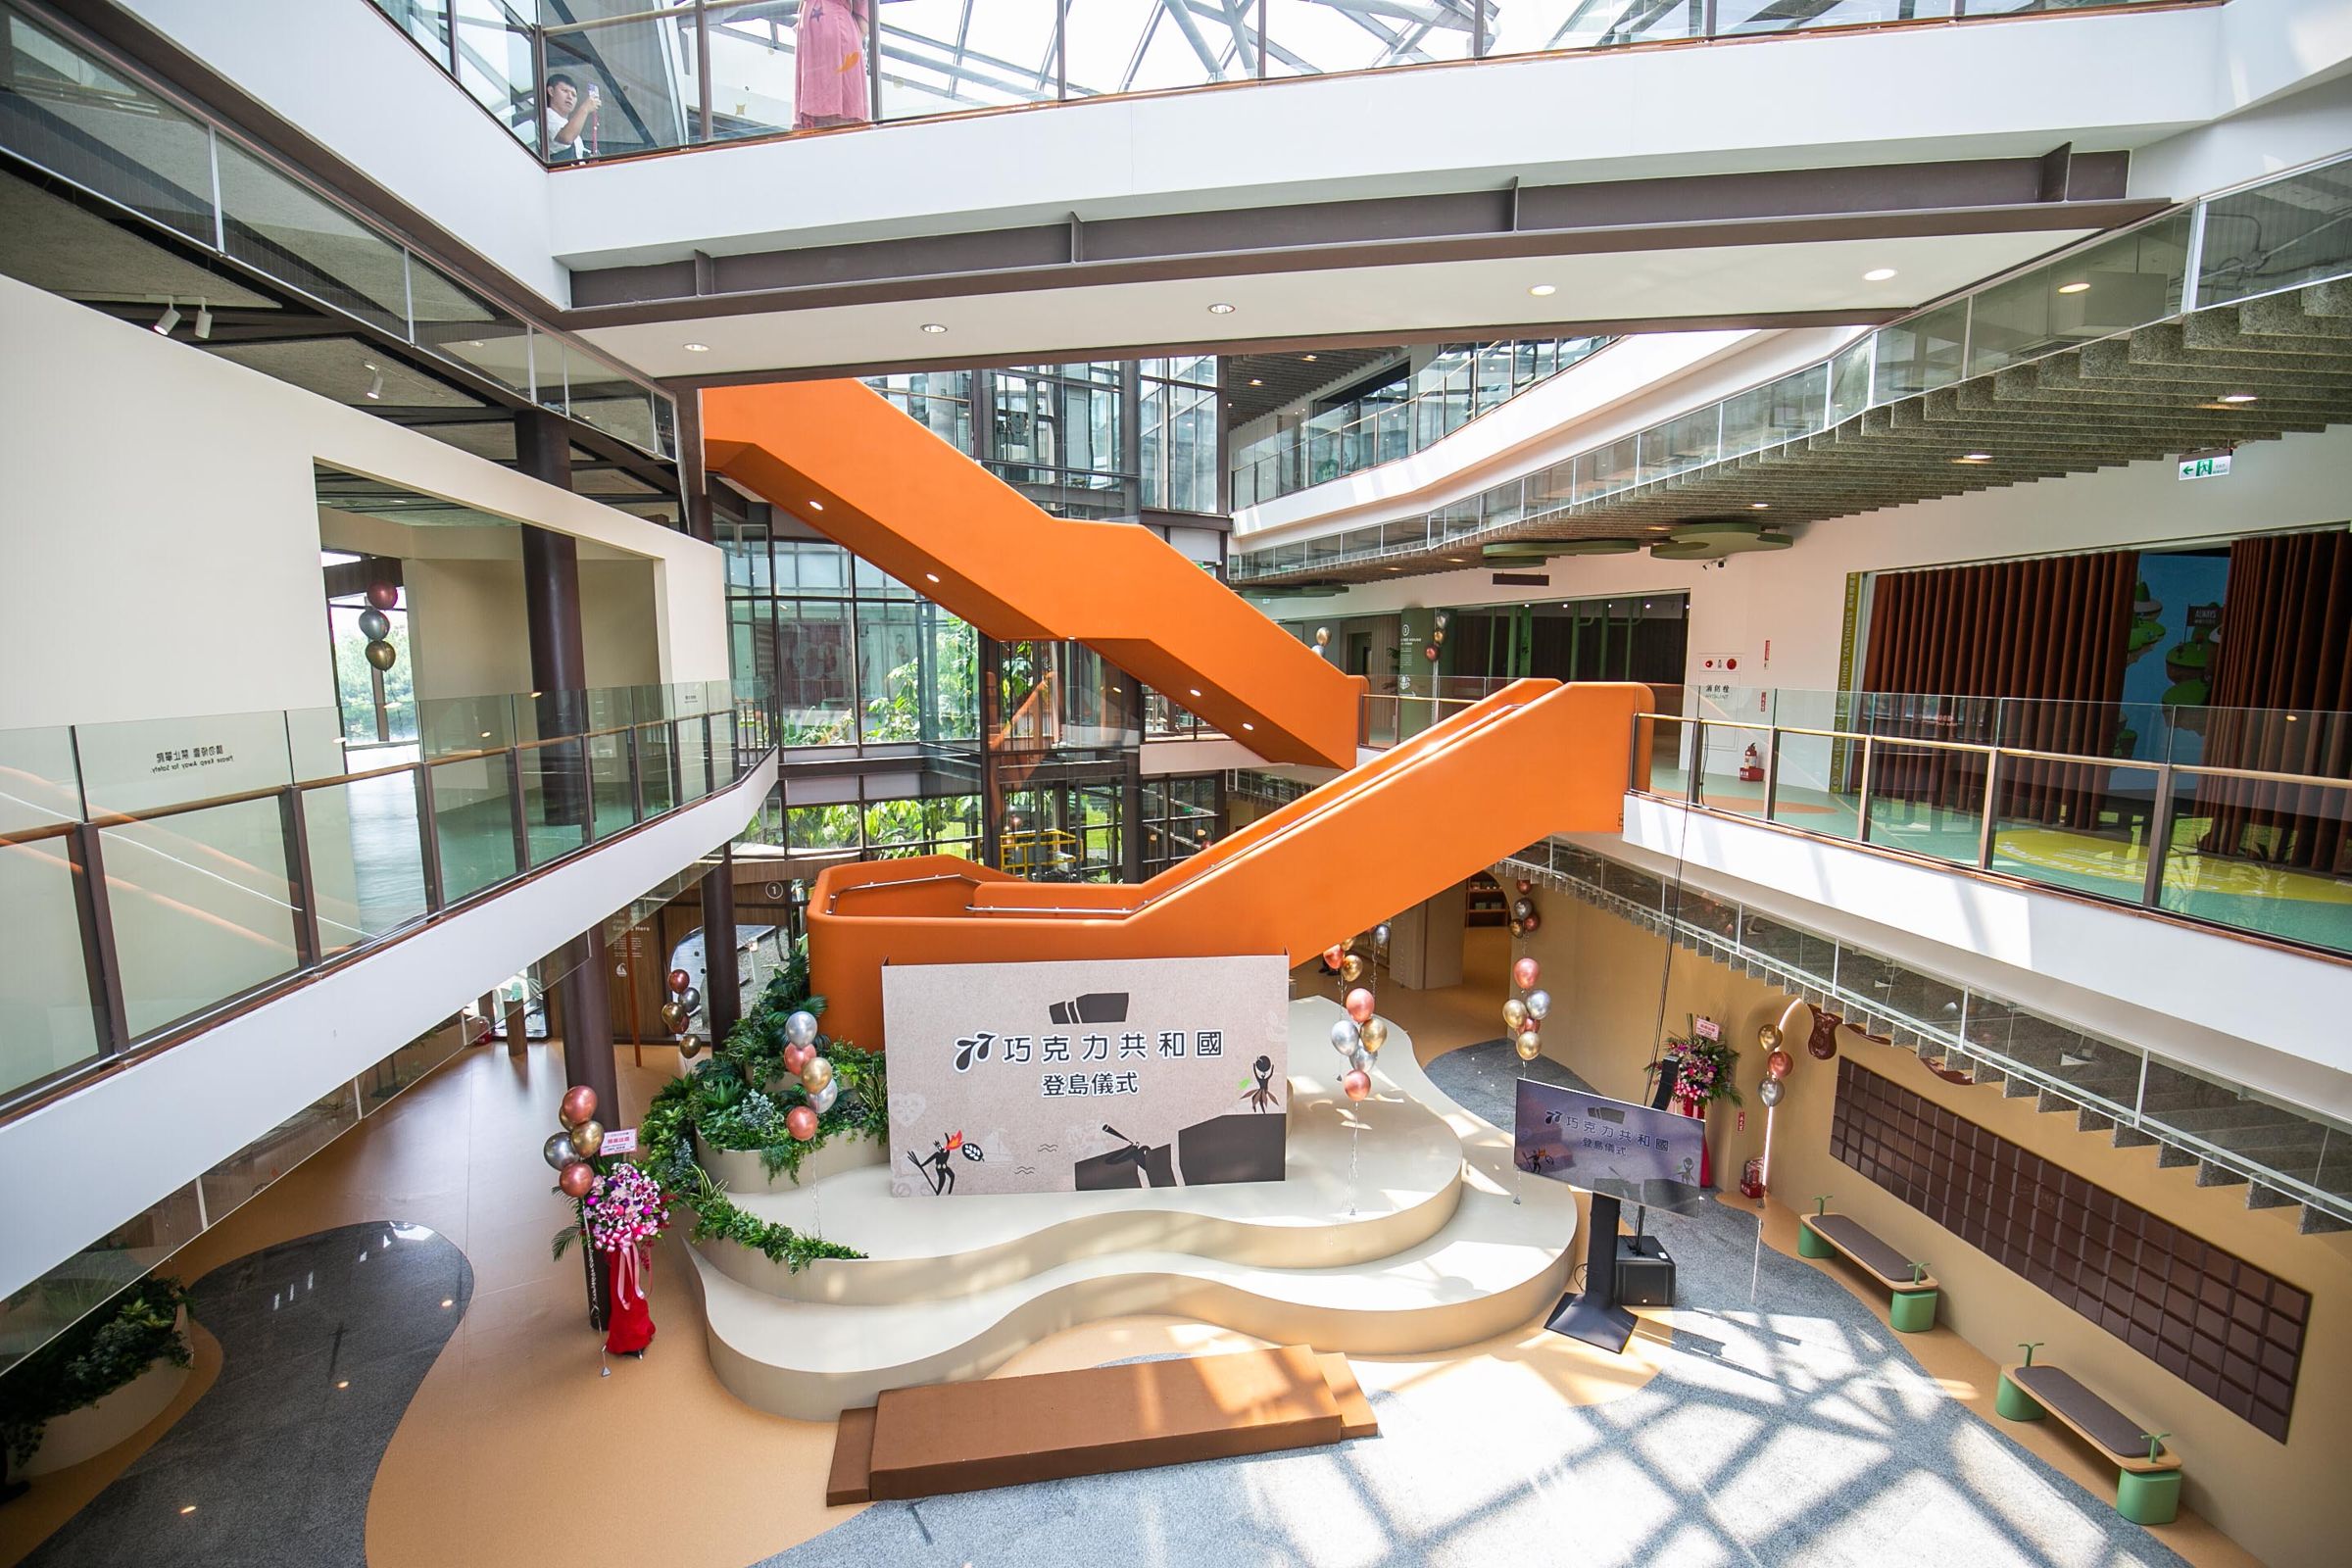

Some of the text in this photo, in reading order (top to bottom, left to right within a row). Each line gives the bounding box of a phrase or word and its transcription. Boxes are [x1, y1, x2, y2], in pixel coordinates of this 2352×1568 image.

[1835, 723, 1843, 756] ISLAD
[1842, 611, 1853, 659] TASTINESS
[1042, 1072, 1139, 1097] 登島儀式
[1583, 1138, 1627, 1156] 登島儀式
